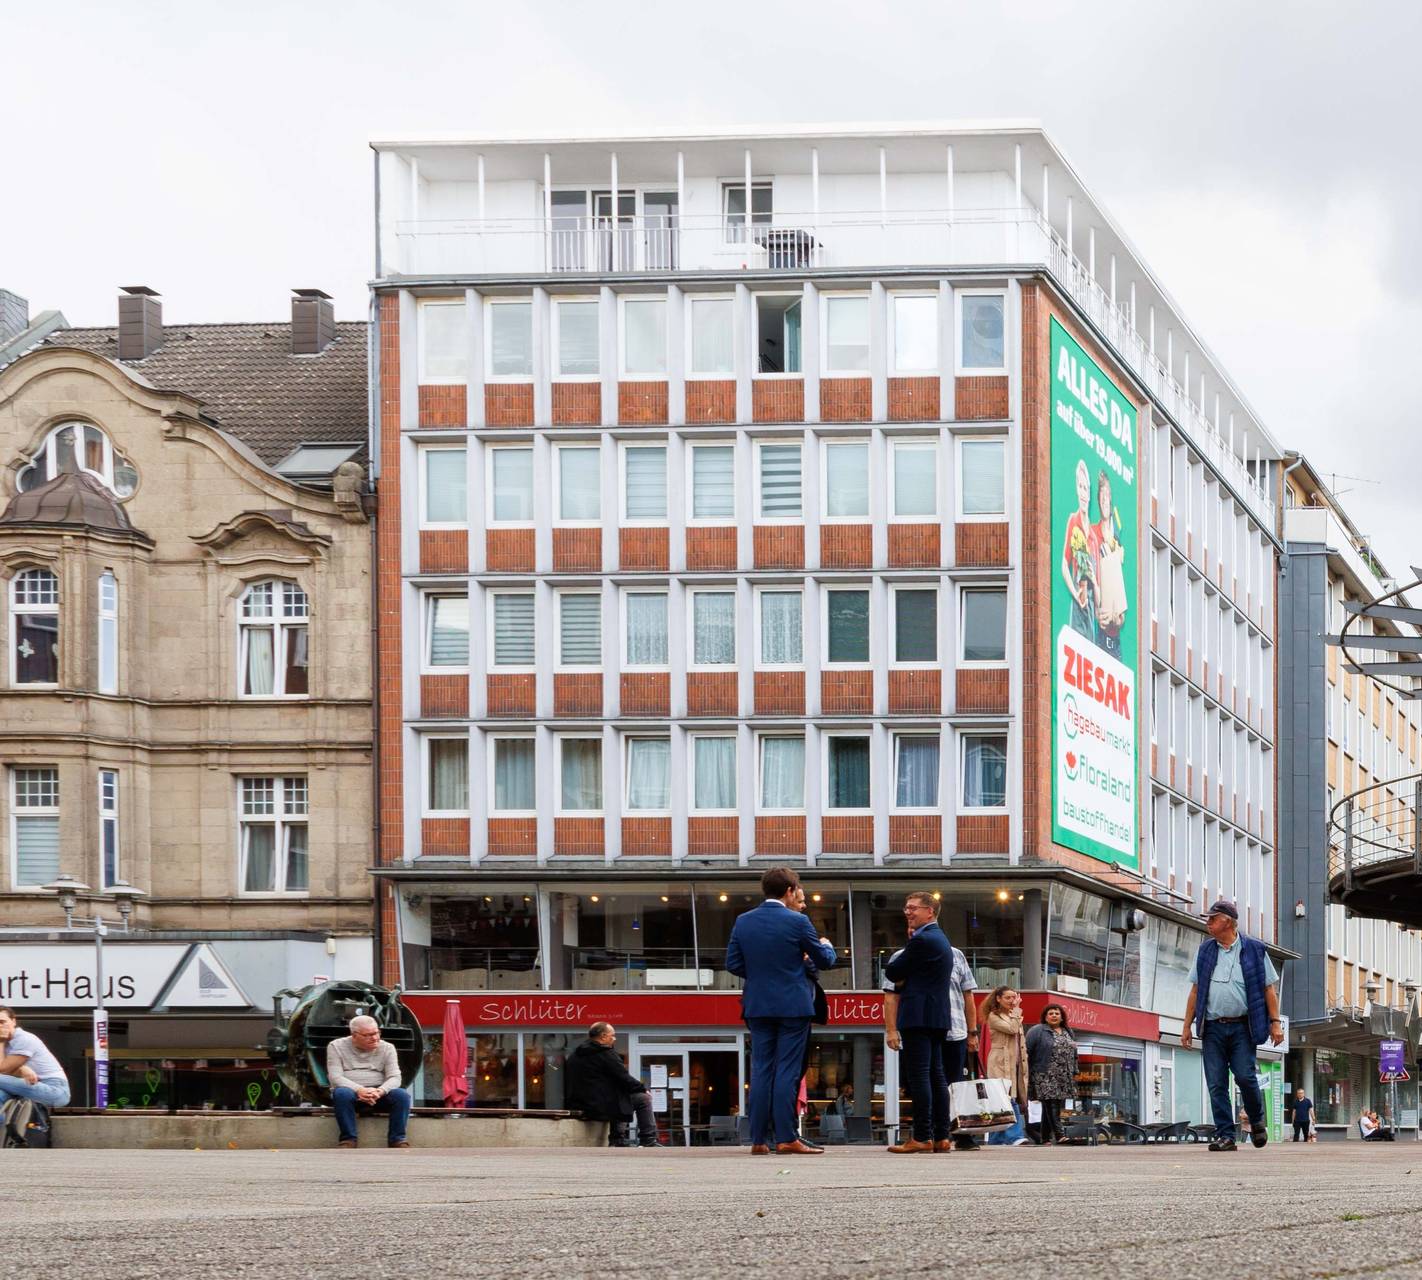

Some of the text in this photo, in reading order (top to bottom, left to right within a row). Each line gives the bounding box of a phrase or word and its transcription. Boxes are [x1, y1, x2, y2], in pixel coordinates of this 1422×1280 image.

[1057, 345, 1134, 454] ALLES DA
[1056, 400, 1073, 427] auf
[1073, 411, 1095, 449] über
[1063, 644, 1131, 721] ZIESAK
[1066, 703, 1131, 756] hagebaumarkt
[1063, 795, 1131, 842] baustoffhandel
[0, 967, 136, 999] rt-Haus
[479, 999, 588, 1021] Schlüter
